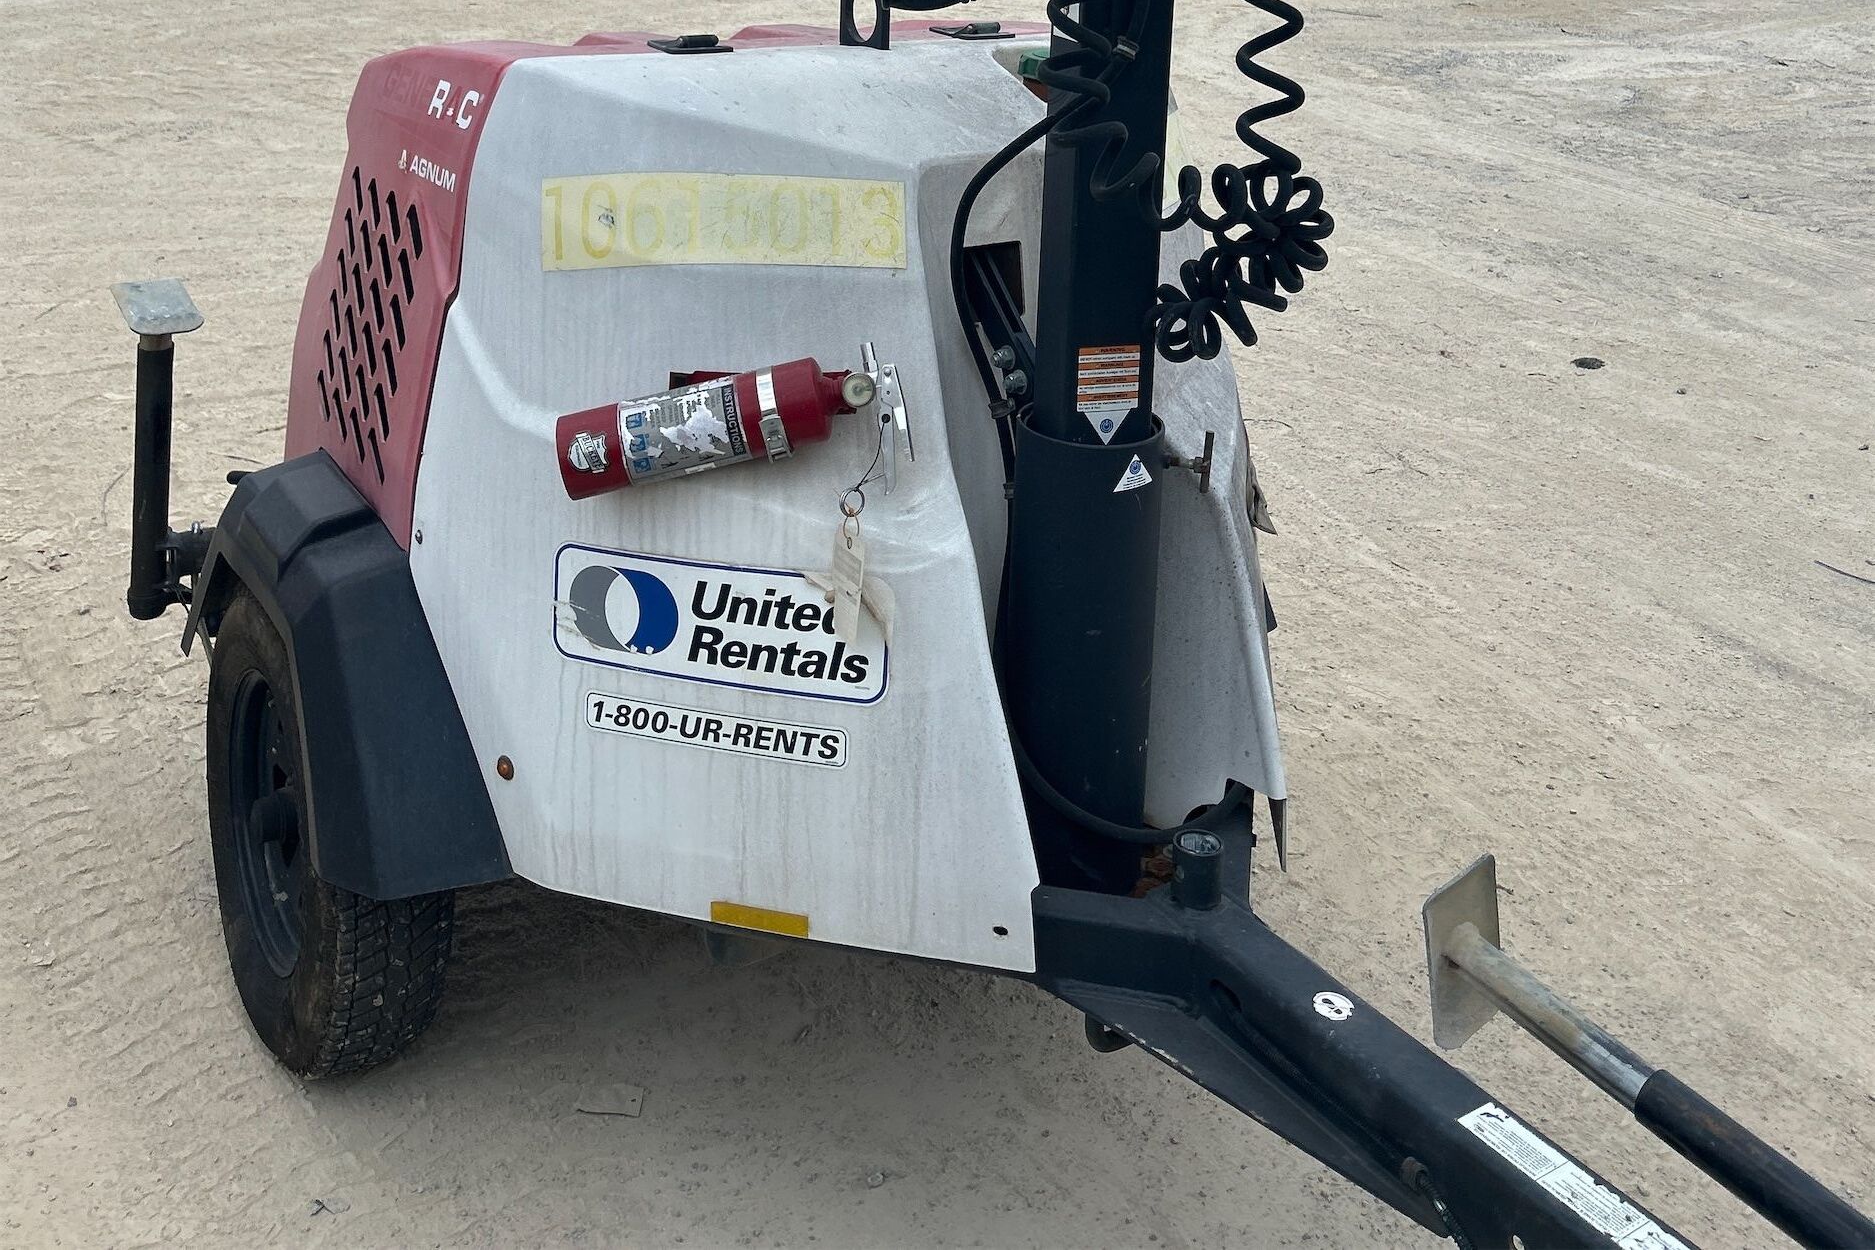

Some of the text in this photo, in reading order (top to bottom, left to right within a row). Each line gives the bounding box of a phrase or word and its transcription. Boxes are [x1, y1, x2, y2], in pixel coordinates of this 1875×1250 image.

[725, 386, 745, 453] INSTRUCTIONS
[687, 624, 869, 684] Rentals
[592, 699, 840, 760] 1-800-UR-RENTS
